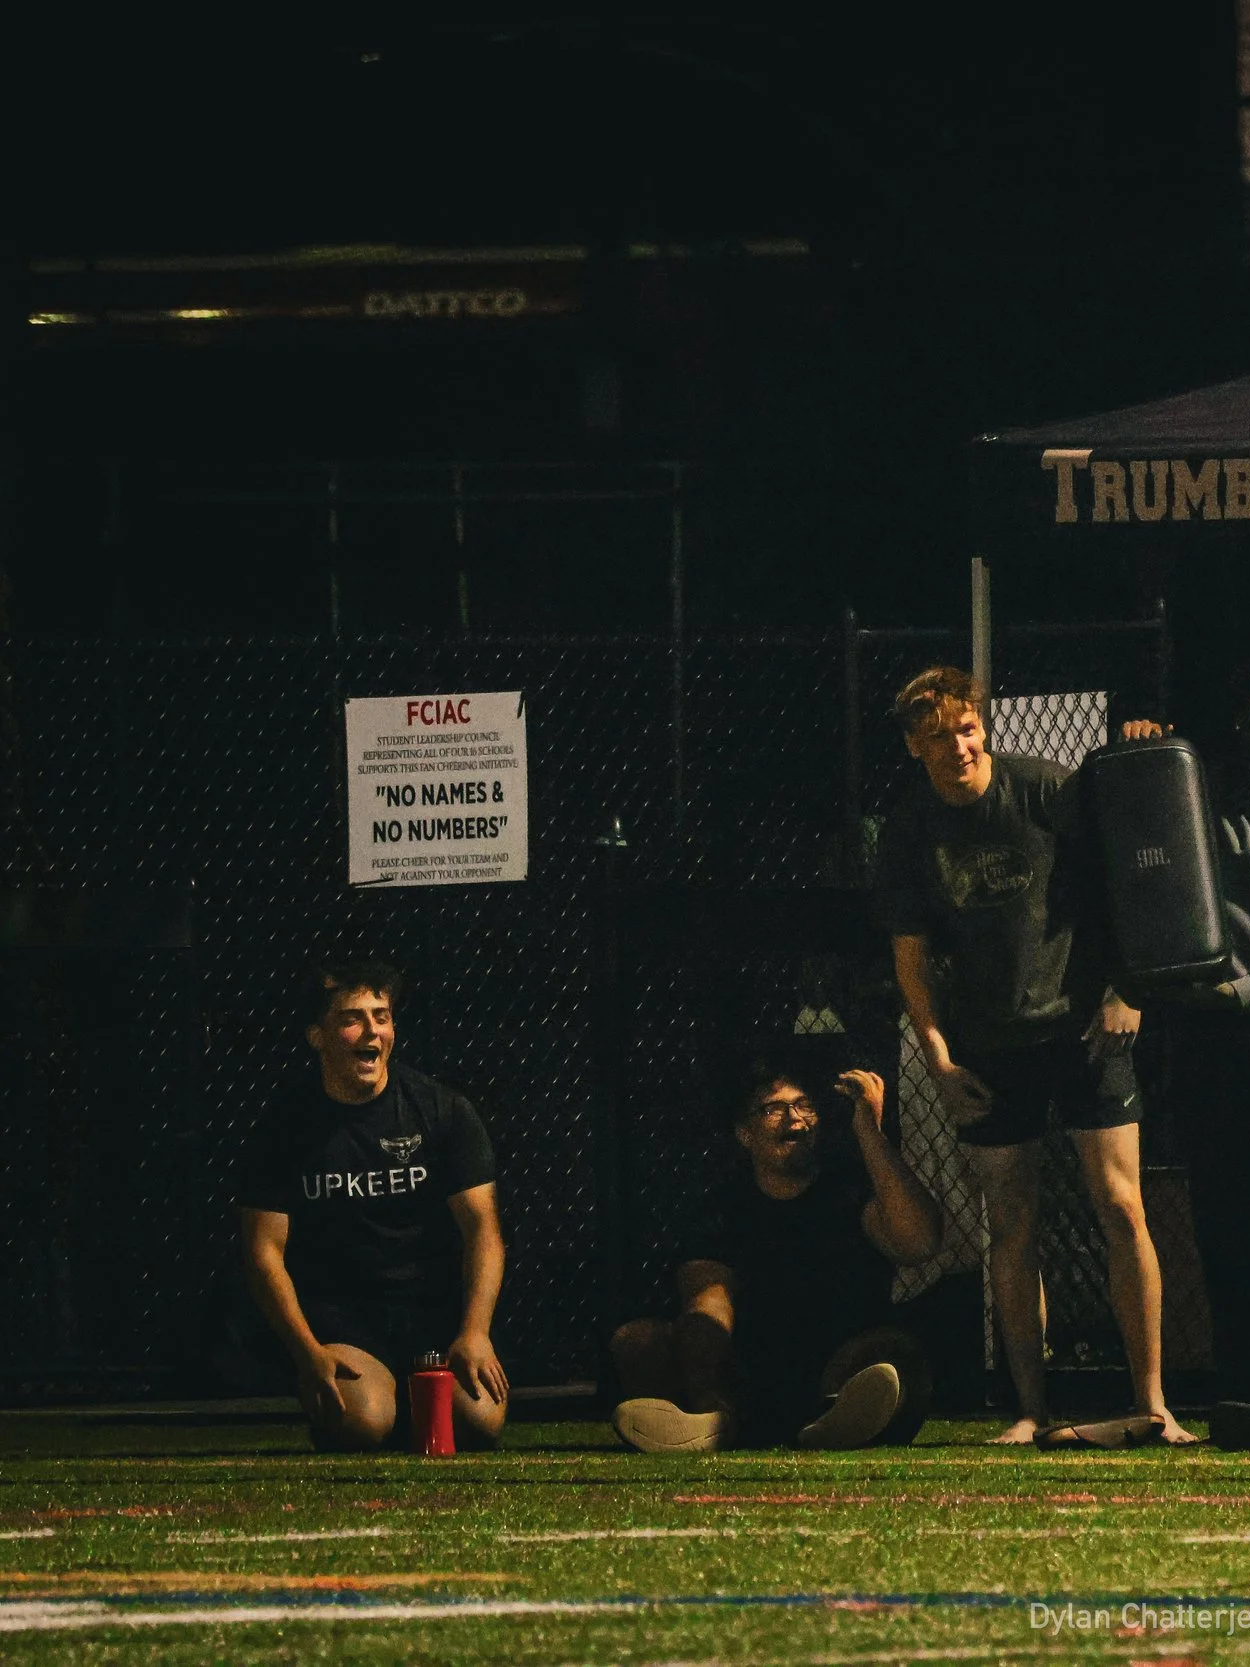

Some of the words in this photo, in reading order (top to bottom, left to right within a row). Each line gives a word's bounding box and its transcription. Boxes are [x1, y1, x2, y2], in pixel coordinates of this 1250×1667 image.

[407, 699, 472, 726] FCIAC
[376, 735, 415, 747] STUDENT
[416, 732, 463, 745] LEADERSHIP
[464, 731, 500, 743] COUNCIL
[363, 749, 422, 761] REPRESENTING
[423, 748, 438, 758] ALL
[439, 747, 450, 758] OF
[450, 746, 468, 757] OUR
[478, 745, 514, 756] SCHOOLS
[357, 763, 398, 775] SUPPORTS
[400, 762, 418, 773] THIS
[419, 761, 435, 772] FAN
[437, 760, 478, 772] CHEERING
[376, 784, 416, 808] "NO
[421, 782, 487, 806] NAMES
[492, 780, 504, 803] &
[373, 820, 401, 843] NO
[408, 815, 508, 842] NUMBERS"
[372, 857, 400, 869] PLEASE
[401, 856, 429, 868] CHEER
[430, 855, 446, 867] FOR
[447, 854, 468, 866] YOUR
[469, 854, 491, 864] TEAM
[492, 852, 509, 864] AND
[400, 870, 436, 881] AGAINST
[437, 869, 460, 880] YOUR
[461, 867, 502, 879] OPPONENT
[302, 1166, 427, 1200] UPKEEP
